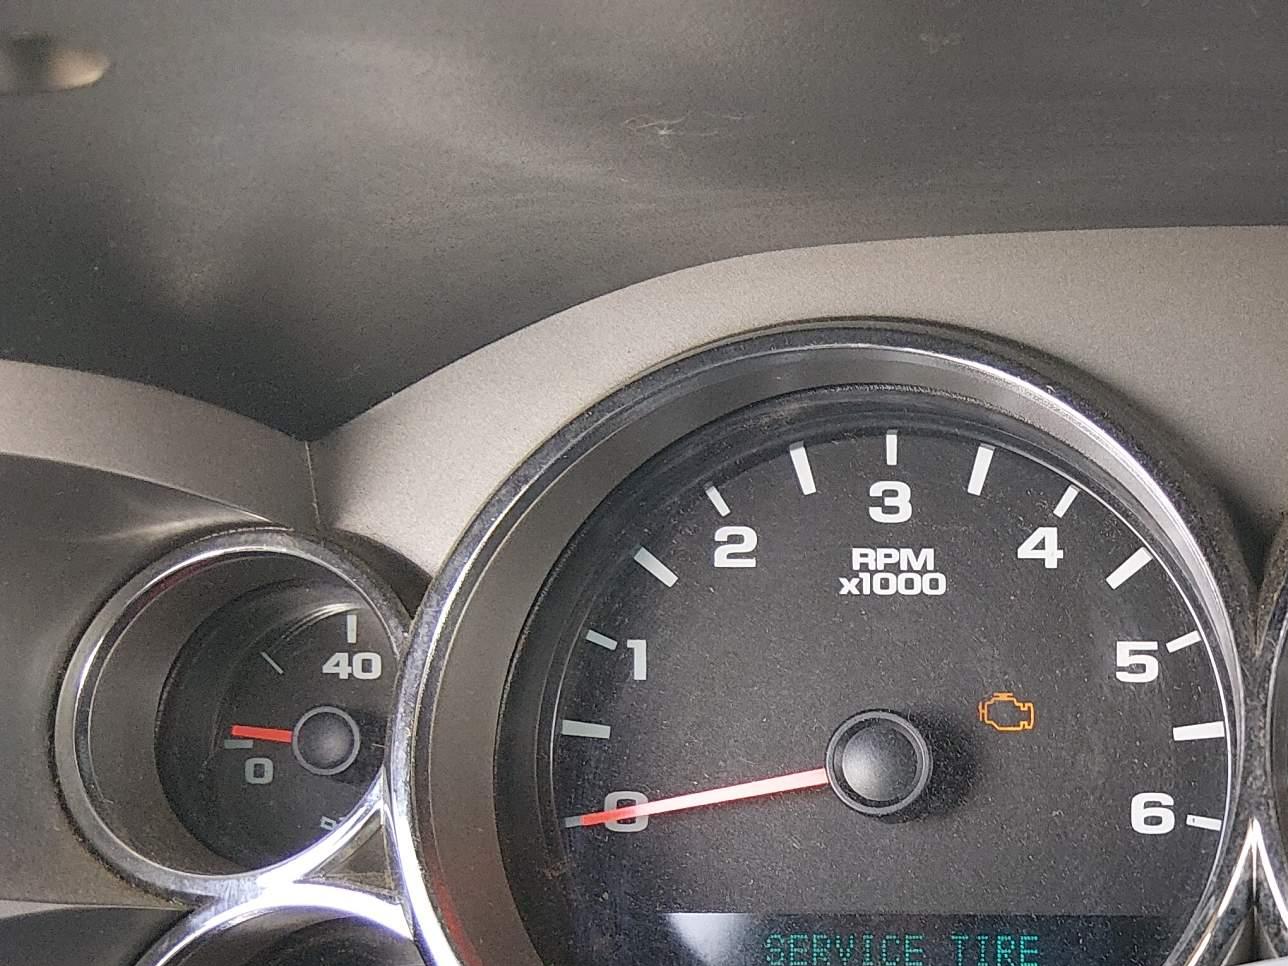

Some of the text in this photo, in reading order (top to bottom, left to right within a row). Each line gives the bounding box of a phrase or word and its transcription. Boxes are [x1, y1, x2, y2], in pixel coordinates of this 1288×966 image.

[868, 481, 912, 523] 3
[713, 526, 758, 568] 2
[851, 547, 935, 571] RPM
[1017, 527, 1064, 569] 4
[838, 572, 946, 596] x1000
[322, 652, 382, 680] 40
[626, 640, 647, 680] 1
[1115, 641, 1159, 683] 5
[245, 757, 273, 784] 0
[604, 791, 648, 833] 0
[1130, 792, 1175, 835] 6
[764, 933, 924, 966] SERVICE
